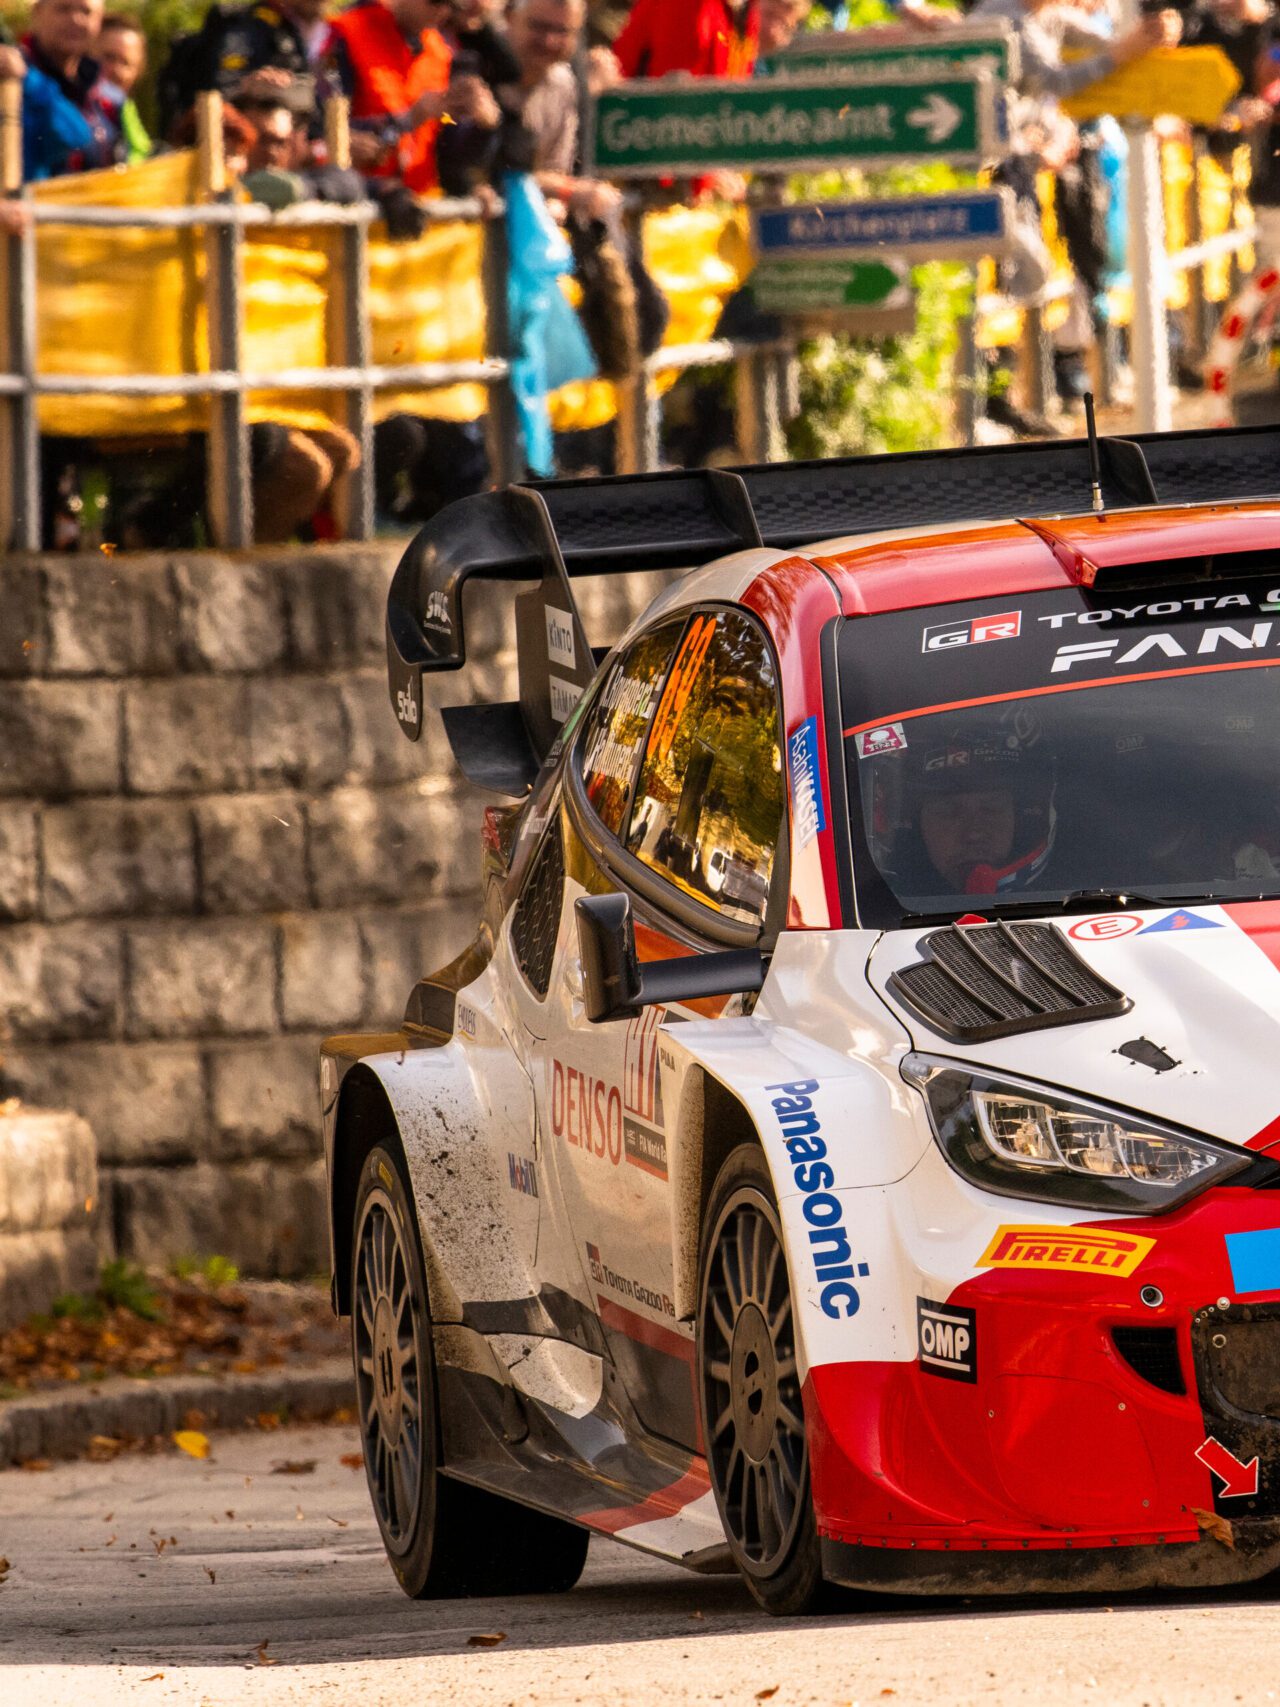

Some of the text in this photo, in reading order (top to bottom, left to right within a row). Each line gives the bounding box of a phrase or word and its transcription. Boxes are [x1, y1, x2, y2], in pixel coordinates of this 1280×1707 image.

[602, 102, 896, 151] Gemeindeamt
[1038, 594, 1251, 629] TOYOTA
[549, 618, 572, 654] KINTO
[926, 619, 1018, 651] GR
[791, 724, 821, 847] AsahiKASEI
[1089, 919, 1123, 936] E
[552, 1058, 622, 1167] DENSO
[763, 1076, 870, 1321] Panasonic
[990, 1230, 1138, 1269] PIRELLI
[602, 1264, 635, 1299] TOYOTA
[633, 1280, 663, 1312] GAZOO
[920, 1318, 971, 1362] OMP
